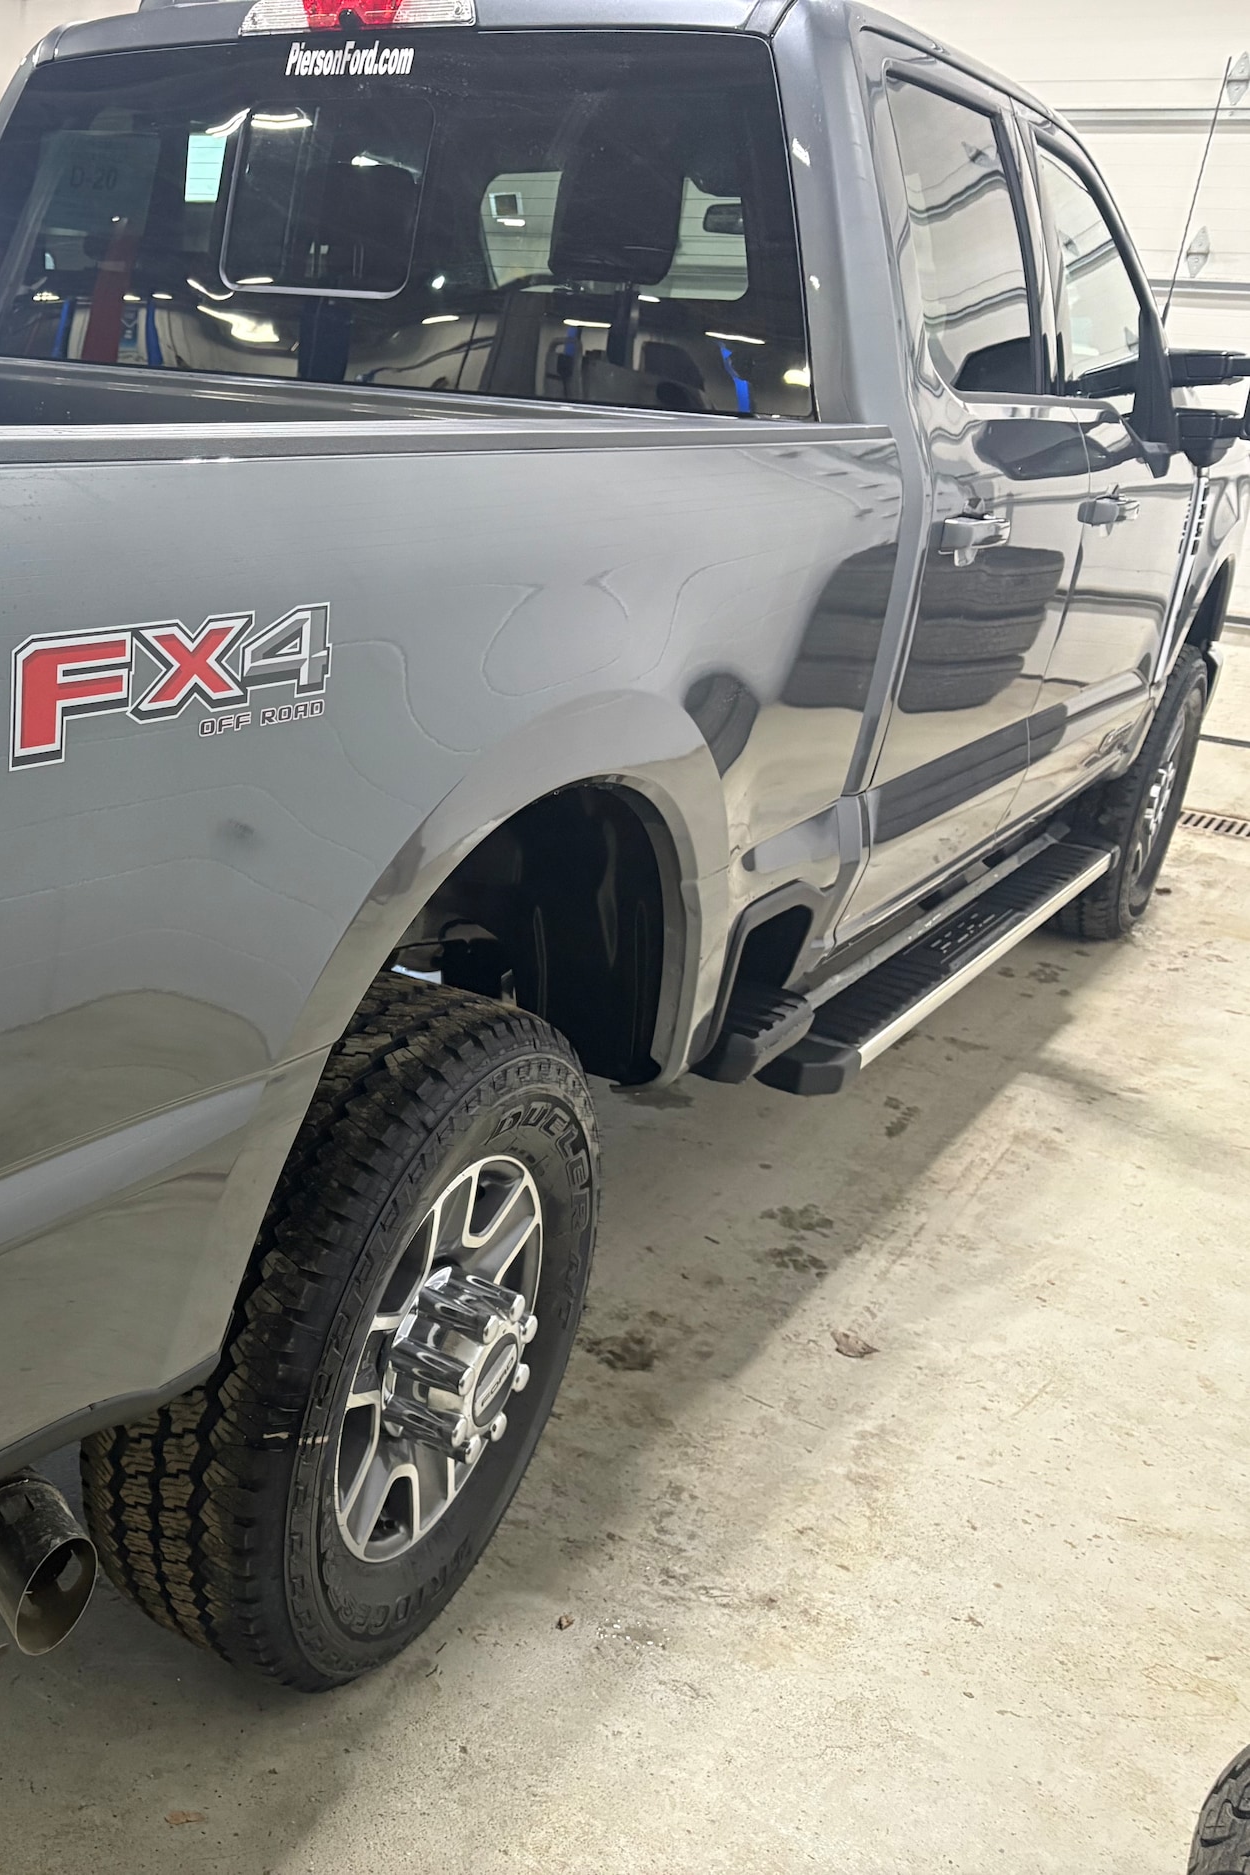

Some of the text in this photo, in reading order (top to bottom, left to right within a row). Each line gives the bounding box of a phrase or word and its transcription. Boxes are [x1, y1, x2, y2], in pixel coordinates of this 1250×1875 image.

[285, 40, 415, 76] PiersonFord.com
[8, 602, 332, 771] FX4
[199, 699, 325, 737] OFF ROAD
[480, 1356, 514, 1408] FORD
